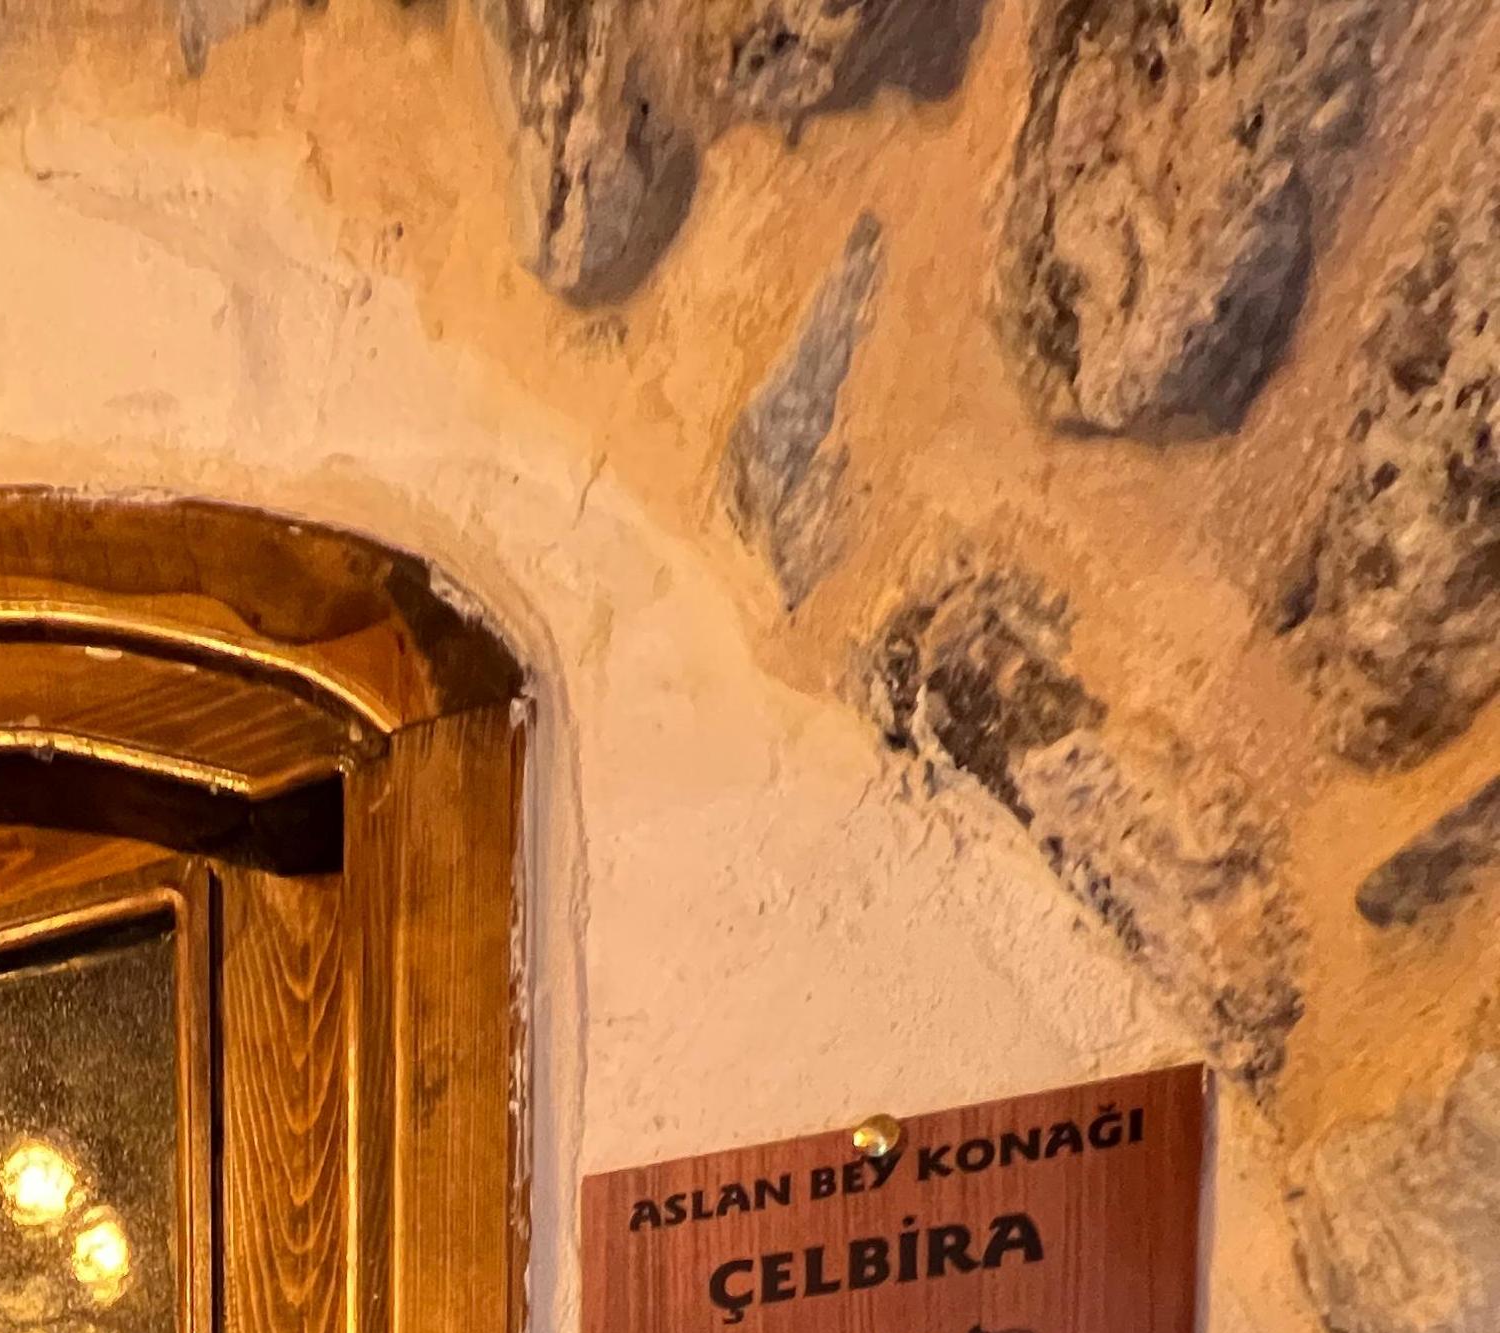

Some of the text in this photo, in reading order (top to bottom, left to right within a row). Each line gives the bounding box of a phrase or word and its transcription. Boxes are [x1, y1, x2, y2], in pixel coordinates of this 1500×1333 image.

[629, 1103, 1144, 1232] ASLAN BEY KONAĞI
[709, 1213, 1043, 1324] ÇELBİRA
